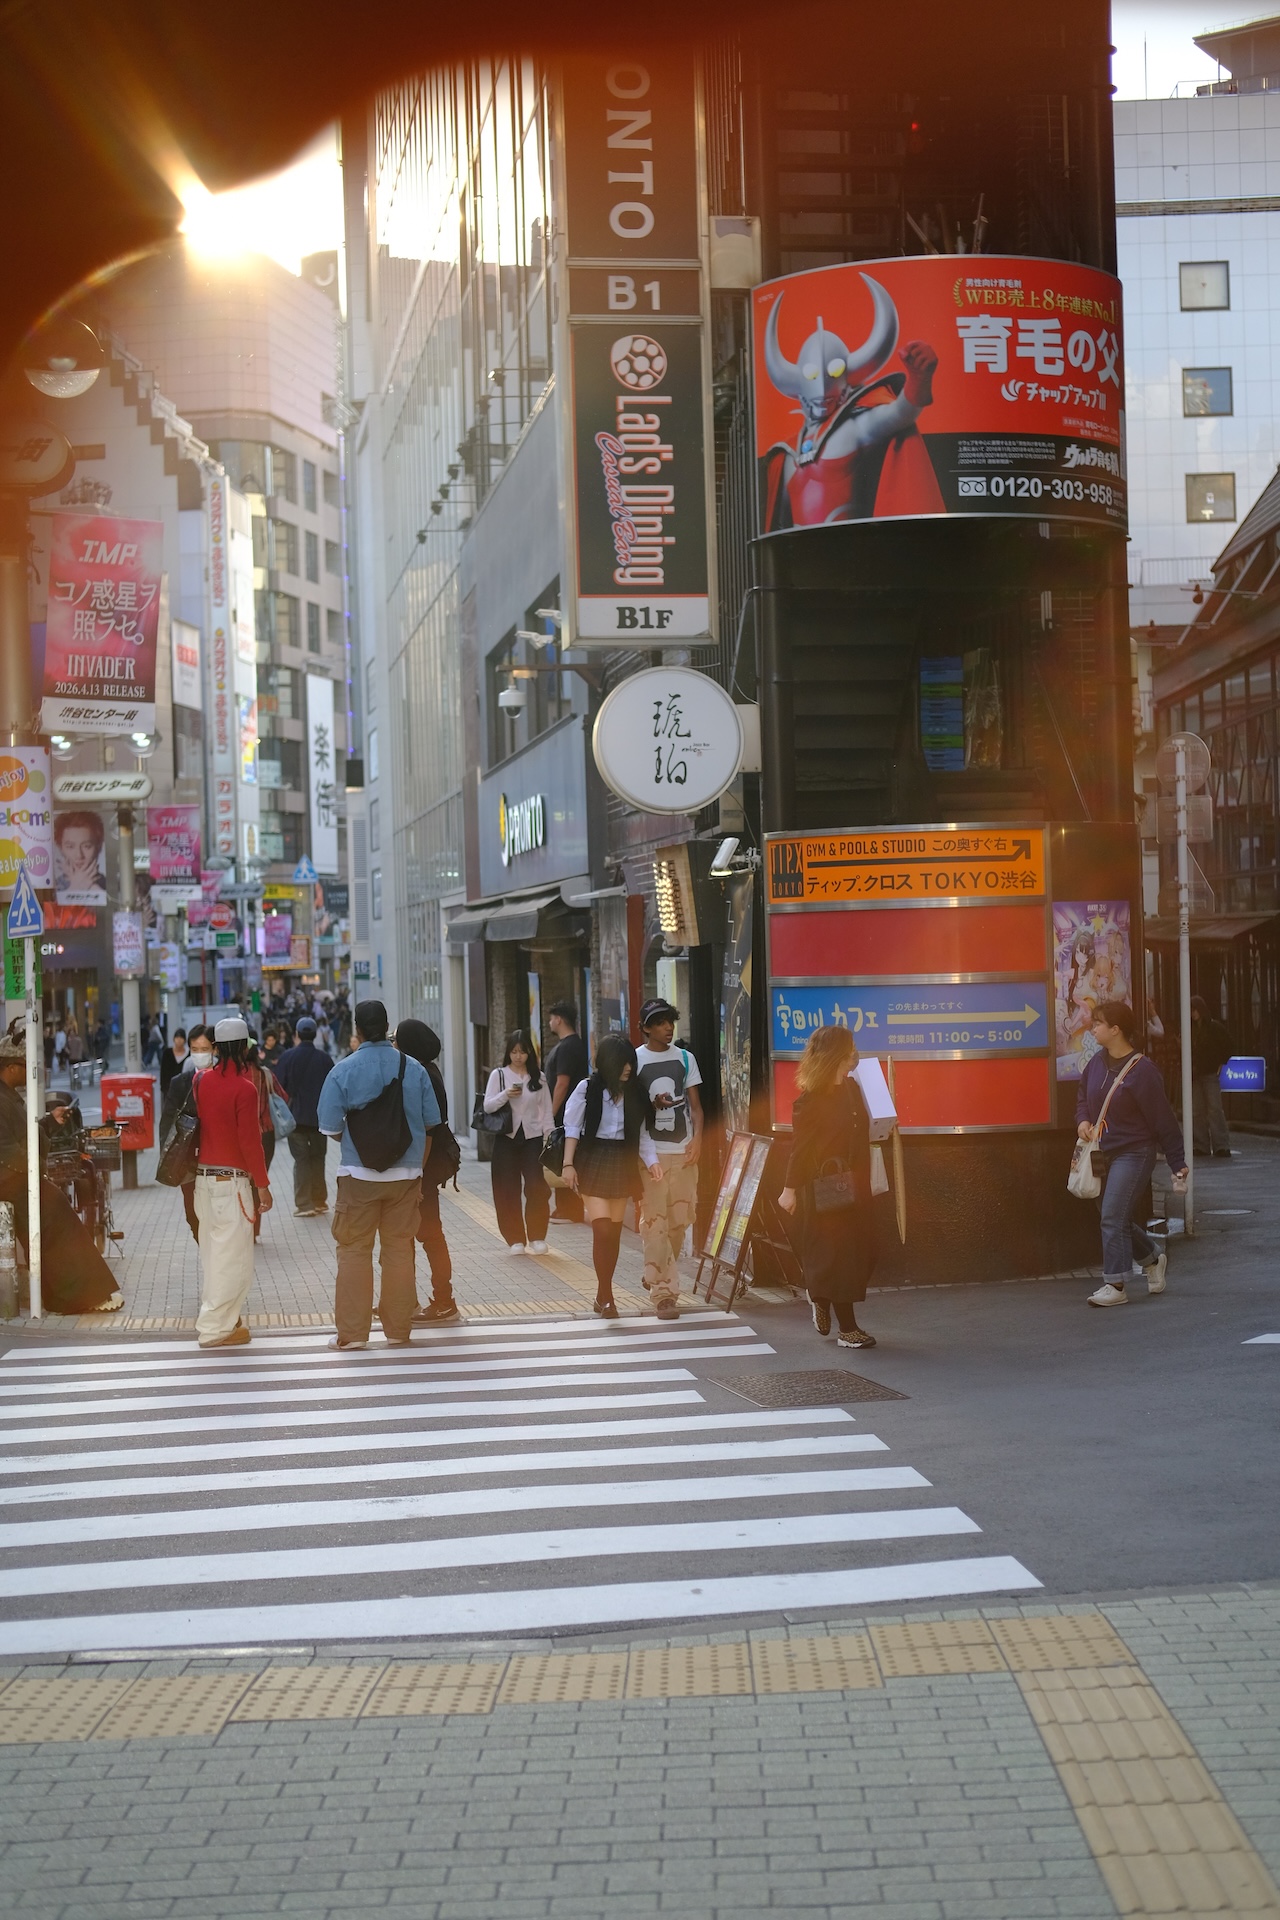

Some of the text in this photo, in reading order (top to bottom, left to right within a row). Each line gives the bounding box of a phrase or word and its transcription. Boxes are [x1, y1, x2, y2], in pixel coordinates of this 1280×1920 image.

[607, 275, 662, 310] B1
[966, 278, 1022, 289] 男性向け育毛剤
[965, 288, 1117, 325] WEB売上8年連続No.1
[956, 314, 1120, 389] 育毛の父
[593, 430, 638, 567] Casual Bar
[612, 395, 676, 586] Lad's Dining
[990, 476, 1114, 507] 0120-303-958
[54, 578, 158, 612] コノ惑星ヲ
[72, 611, 145, 646] 照ラセ。
[616, 605, 674, 630] B1F
[66, 654, 136, 681] INVADER
[54, 681, 146, 698] 2026.4.13 RELEASE
[59, 706, 138, 721] 渋谷センター街
[57, 780, 146, 794] 渋谷センター街
[508, 792, 545, 858] PRONTO
[806, 843, 827, 858] GYM
[828, 843, 836, 857] &
[882, 838, 927, 854] STUDIO
[932, 837, 1007, 853] この奥すぐ右
[772, 881, 803, 897] TOKYO
[831, 1002, 879, 1033] カフェ
[888, 1001, 964, 1012] この先まわってすぐ
[887, 1034, 925, 1045] 営業時間
